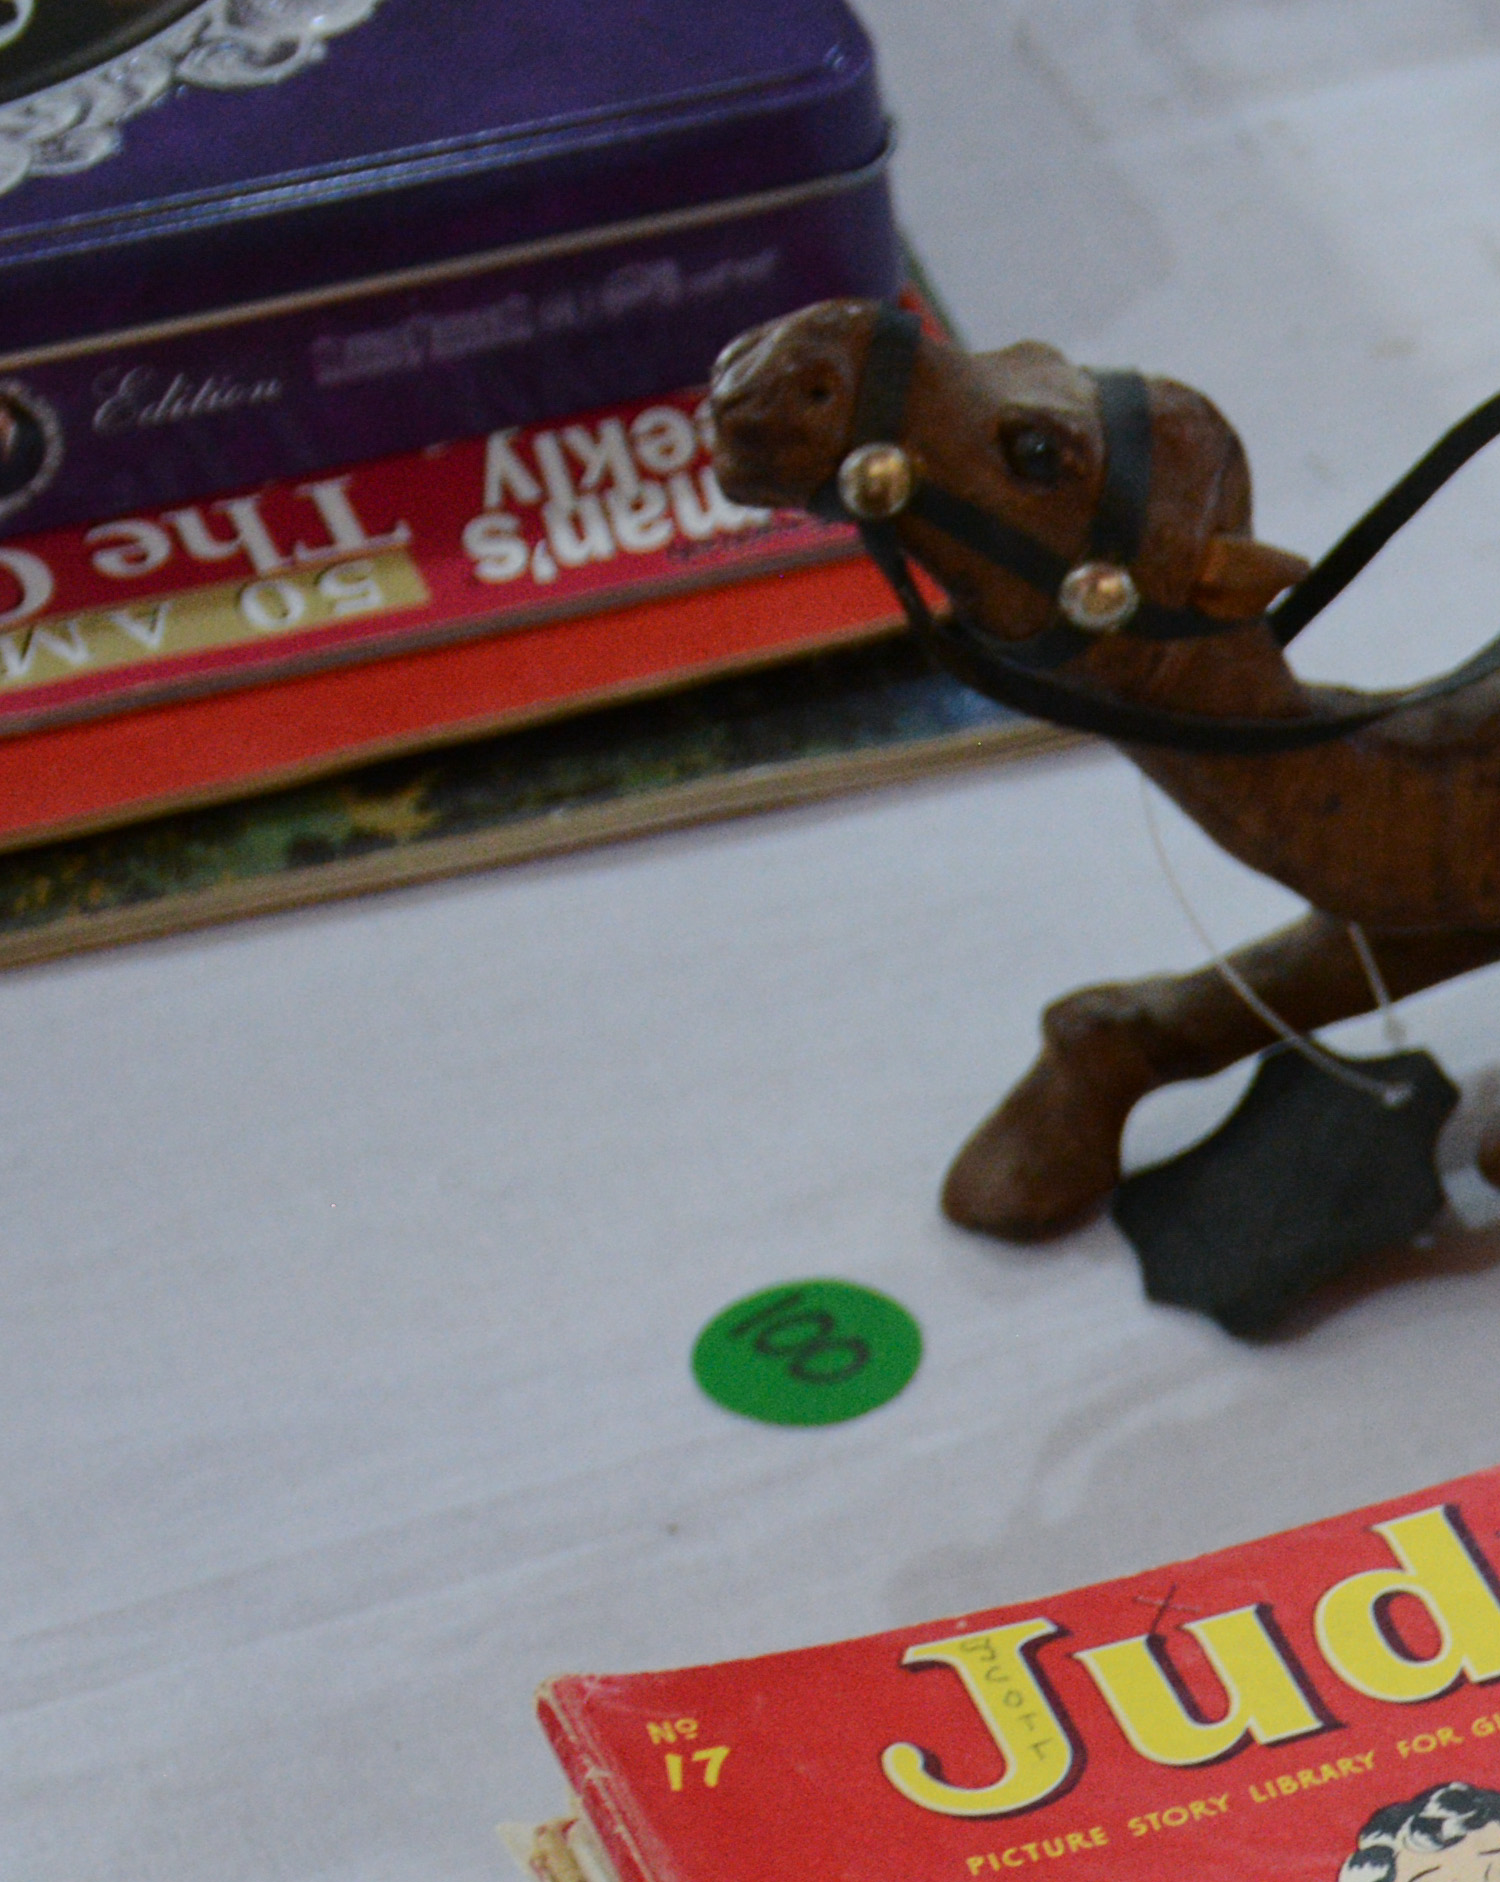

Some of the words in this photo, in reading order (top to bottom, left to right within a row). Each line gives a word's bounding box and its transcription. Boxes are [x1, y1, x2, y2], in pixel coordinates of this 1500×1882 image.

[485, 404, 715, 512] ekly
[86, 477, 411, 577] The
[464, 484, 770, 583] man's
[236, 563, 384, 631] 50
[728, 1293, 871, 1384] 100
[665, 1745, 732, 1791] 17
[967, 1827, 1109, 1877] PICTURE
[1127, 1793, 1232, 1839] STORY
[1251, 1749, 1376, 1806] LIBRARY
[1397, 1721, 1464, 1763] FOR
